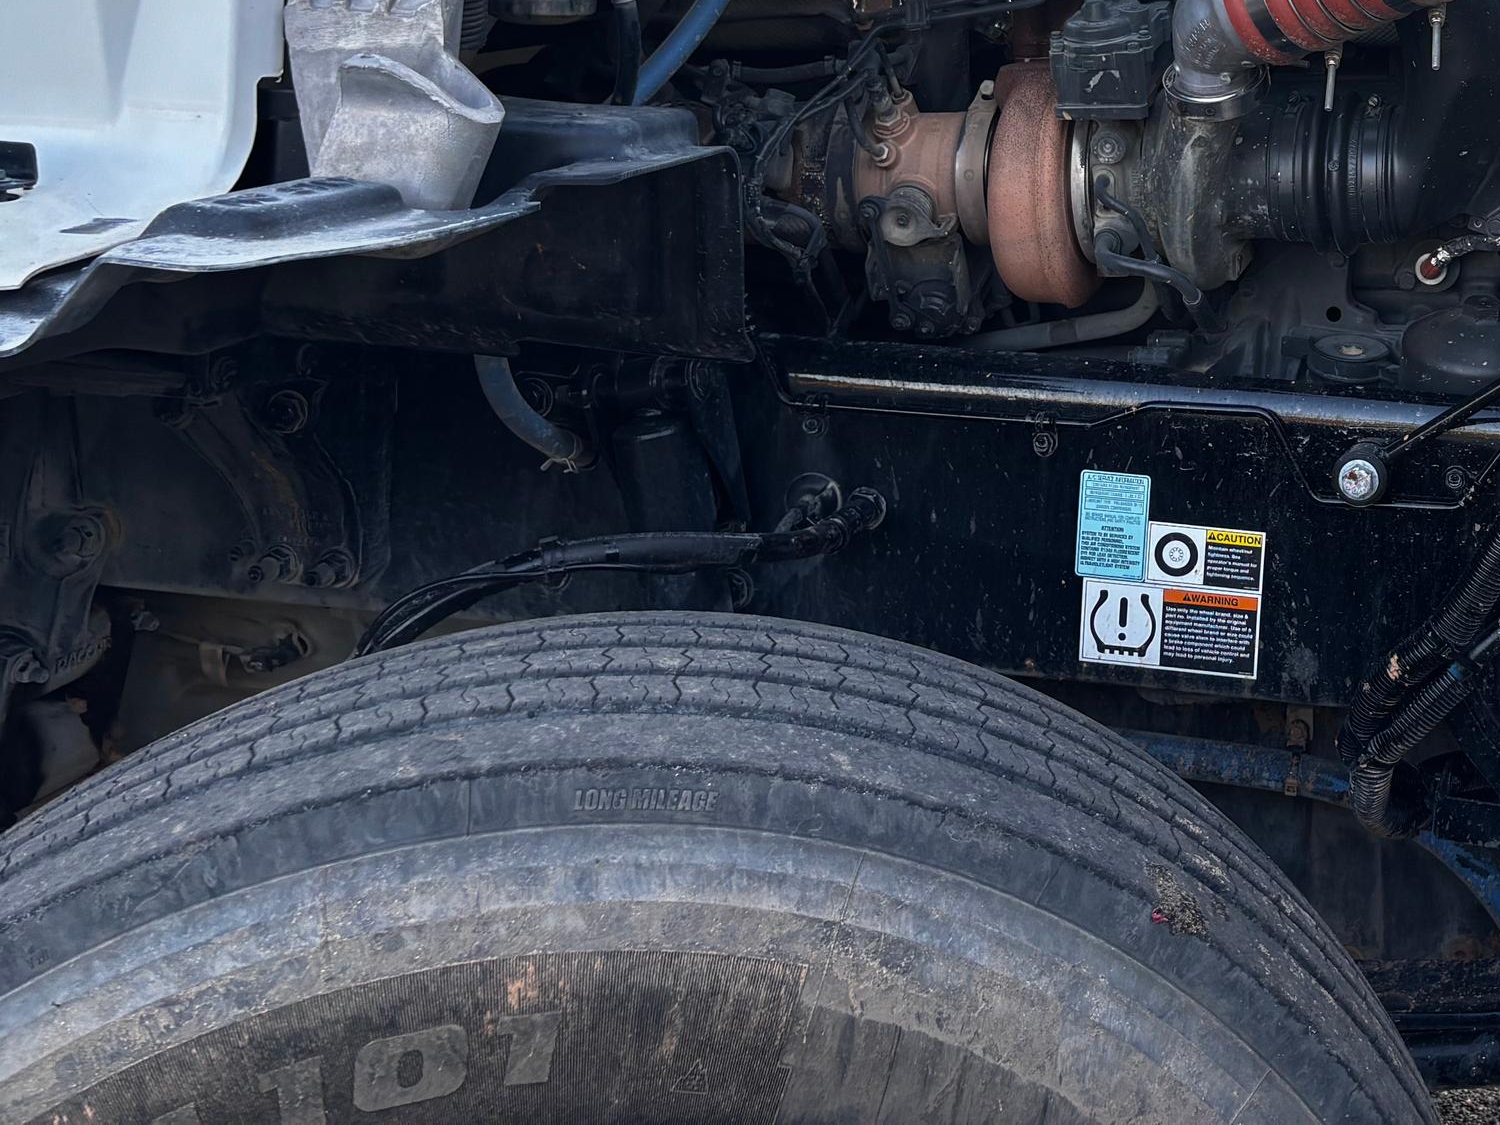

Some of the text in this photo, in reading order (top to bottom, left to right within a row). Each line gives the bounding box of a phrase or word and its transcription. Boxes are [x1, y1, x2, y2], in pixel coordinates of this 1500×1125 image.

[1217, 533, 1261, 545] CAUTION
[1192, 595, 1238, 606] WARNING
[574, 787, 720, 812] LONG MILEAGE
